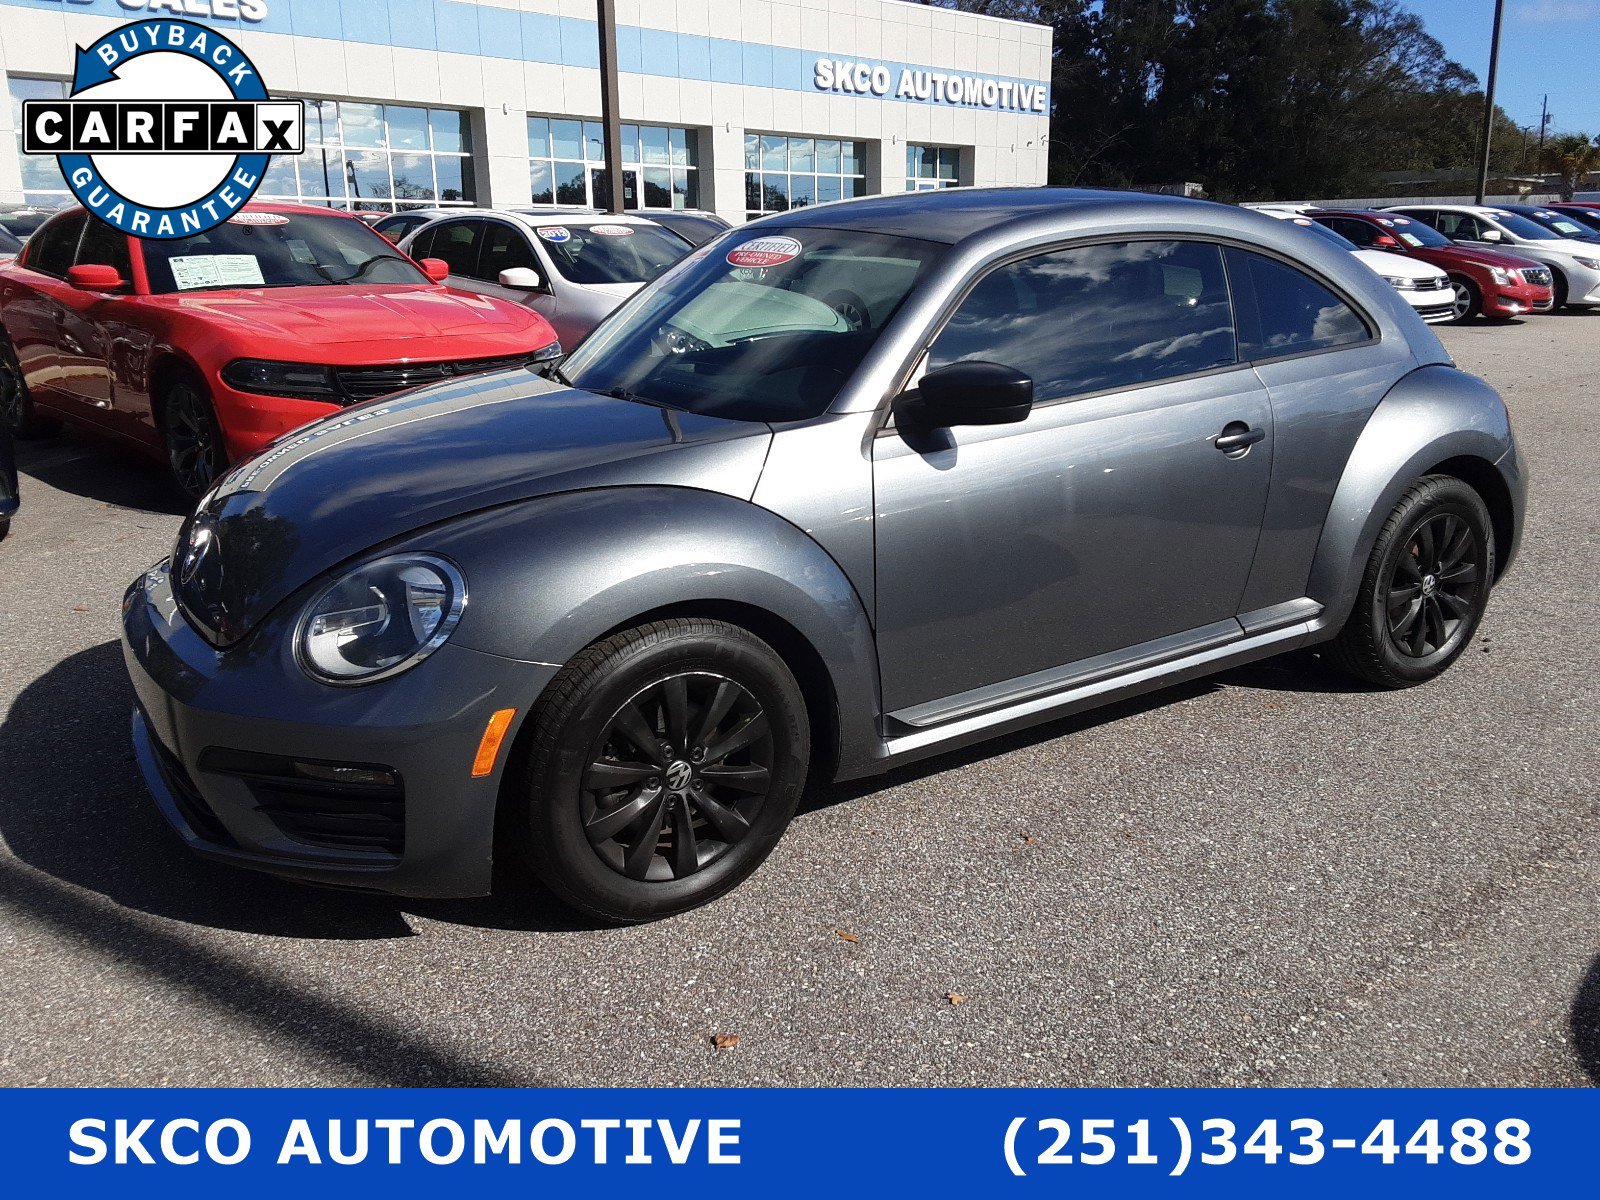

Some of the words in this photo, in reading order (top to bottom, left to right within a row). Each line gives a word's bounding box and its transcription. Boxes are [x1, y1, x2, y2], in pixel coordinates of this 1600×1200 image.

[814, 58, 890, 96] SKCO
[895, 69, 1046, 112] AUTOMOTIVE
[741, 241, 797, 253] CERTIFIED
